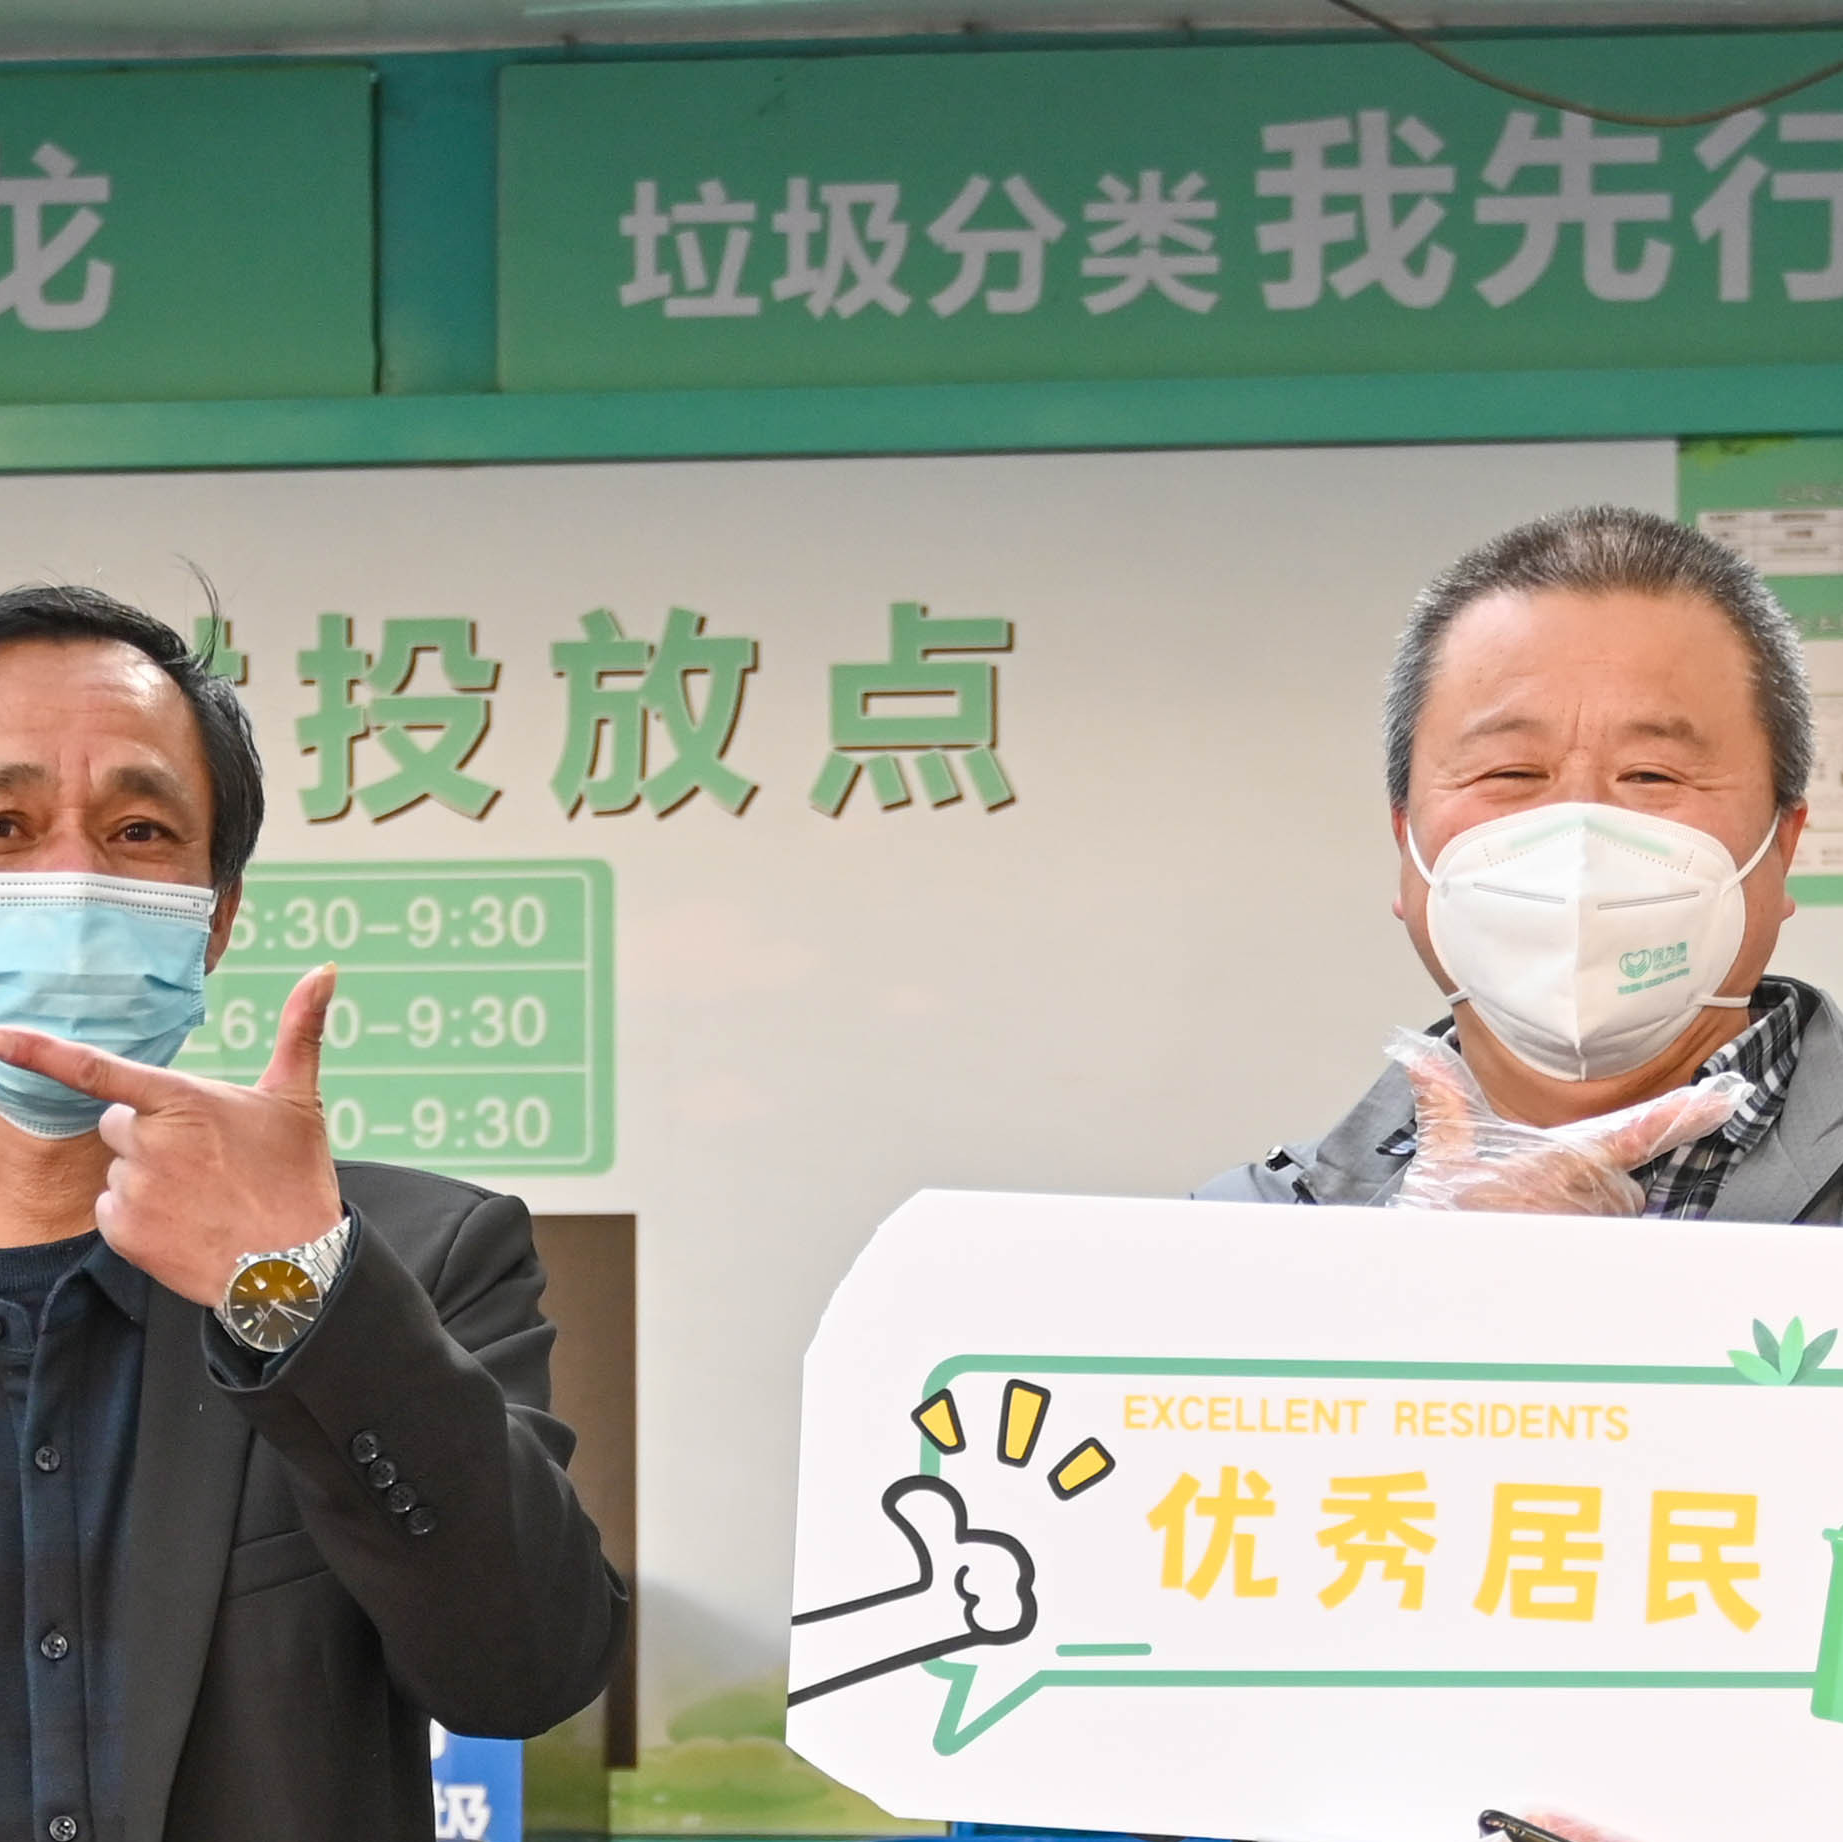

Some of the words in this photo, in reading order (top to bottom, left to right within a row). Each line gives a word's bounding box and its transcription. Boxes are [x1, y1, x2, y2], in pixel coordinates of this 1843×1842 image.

[1123, 1394, 1366, 1436] EXCELLENT
[1393, 1401, 1630, 1443] RESIDENTS
[1146, 1464, 1762, 1632] 优秀居民
